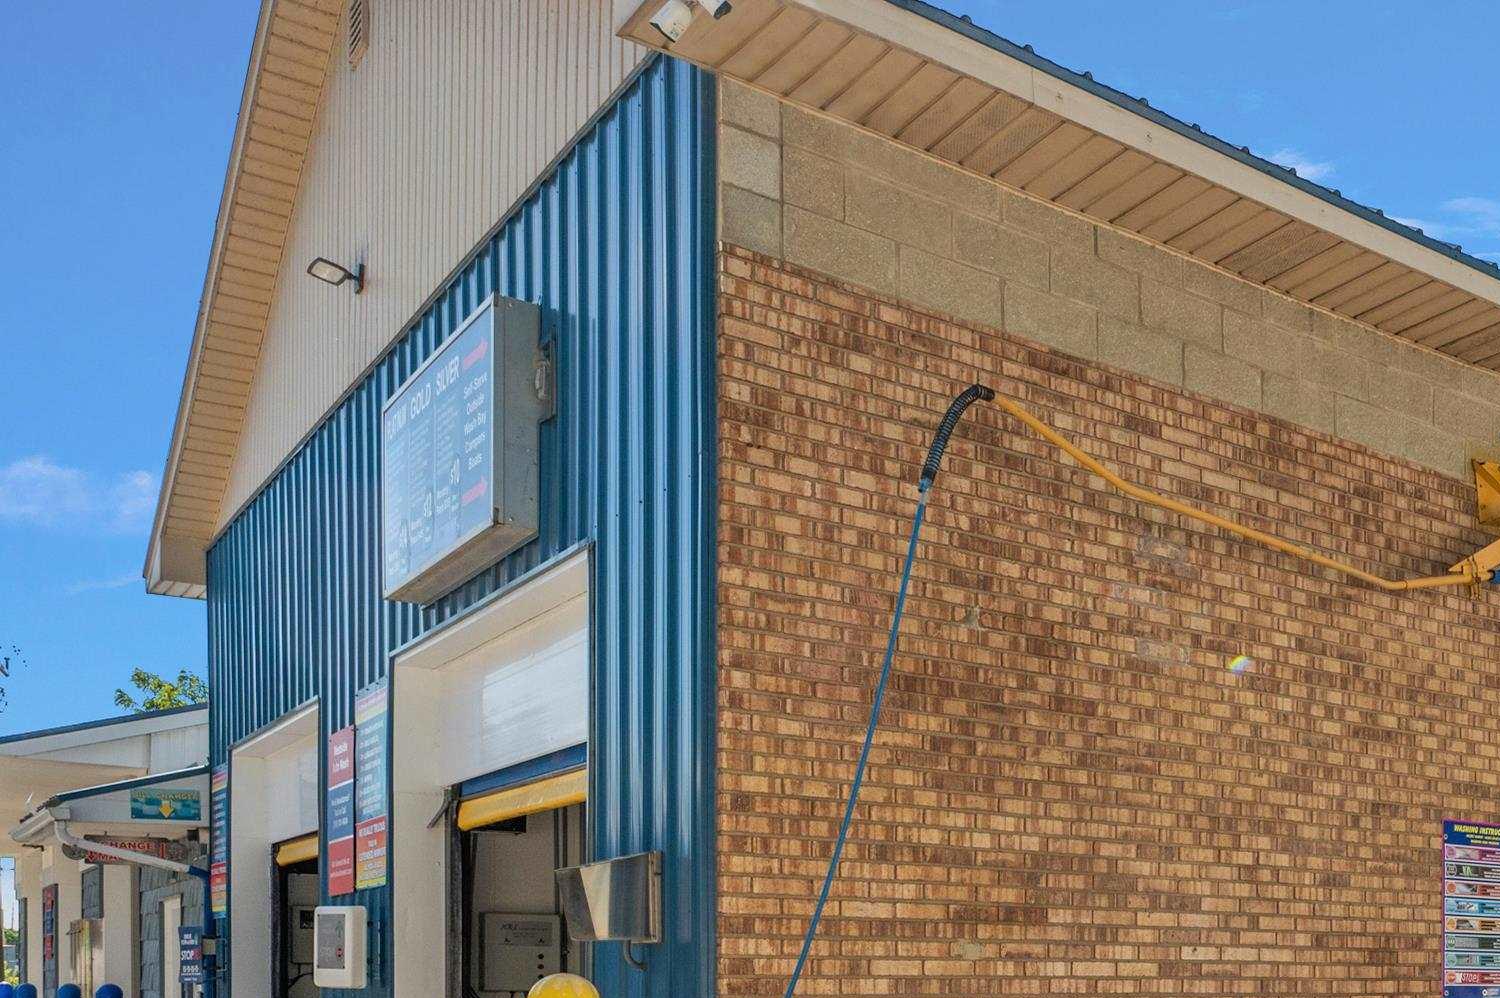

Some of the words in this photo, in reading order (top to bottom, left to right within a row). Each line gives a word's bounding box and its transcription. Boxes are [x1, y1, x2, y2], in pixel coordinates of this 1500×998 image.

[410, 384, 432, 418] GOLD
[436, 355, 461, 396] SILVER
[1454, 824, 1479, 834] WASHING
